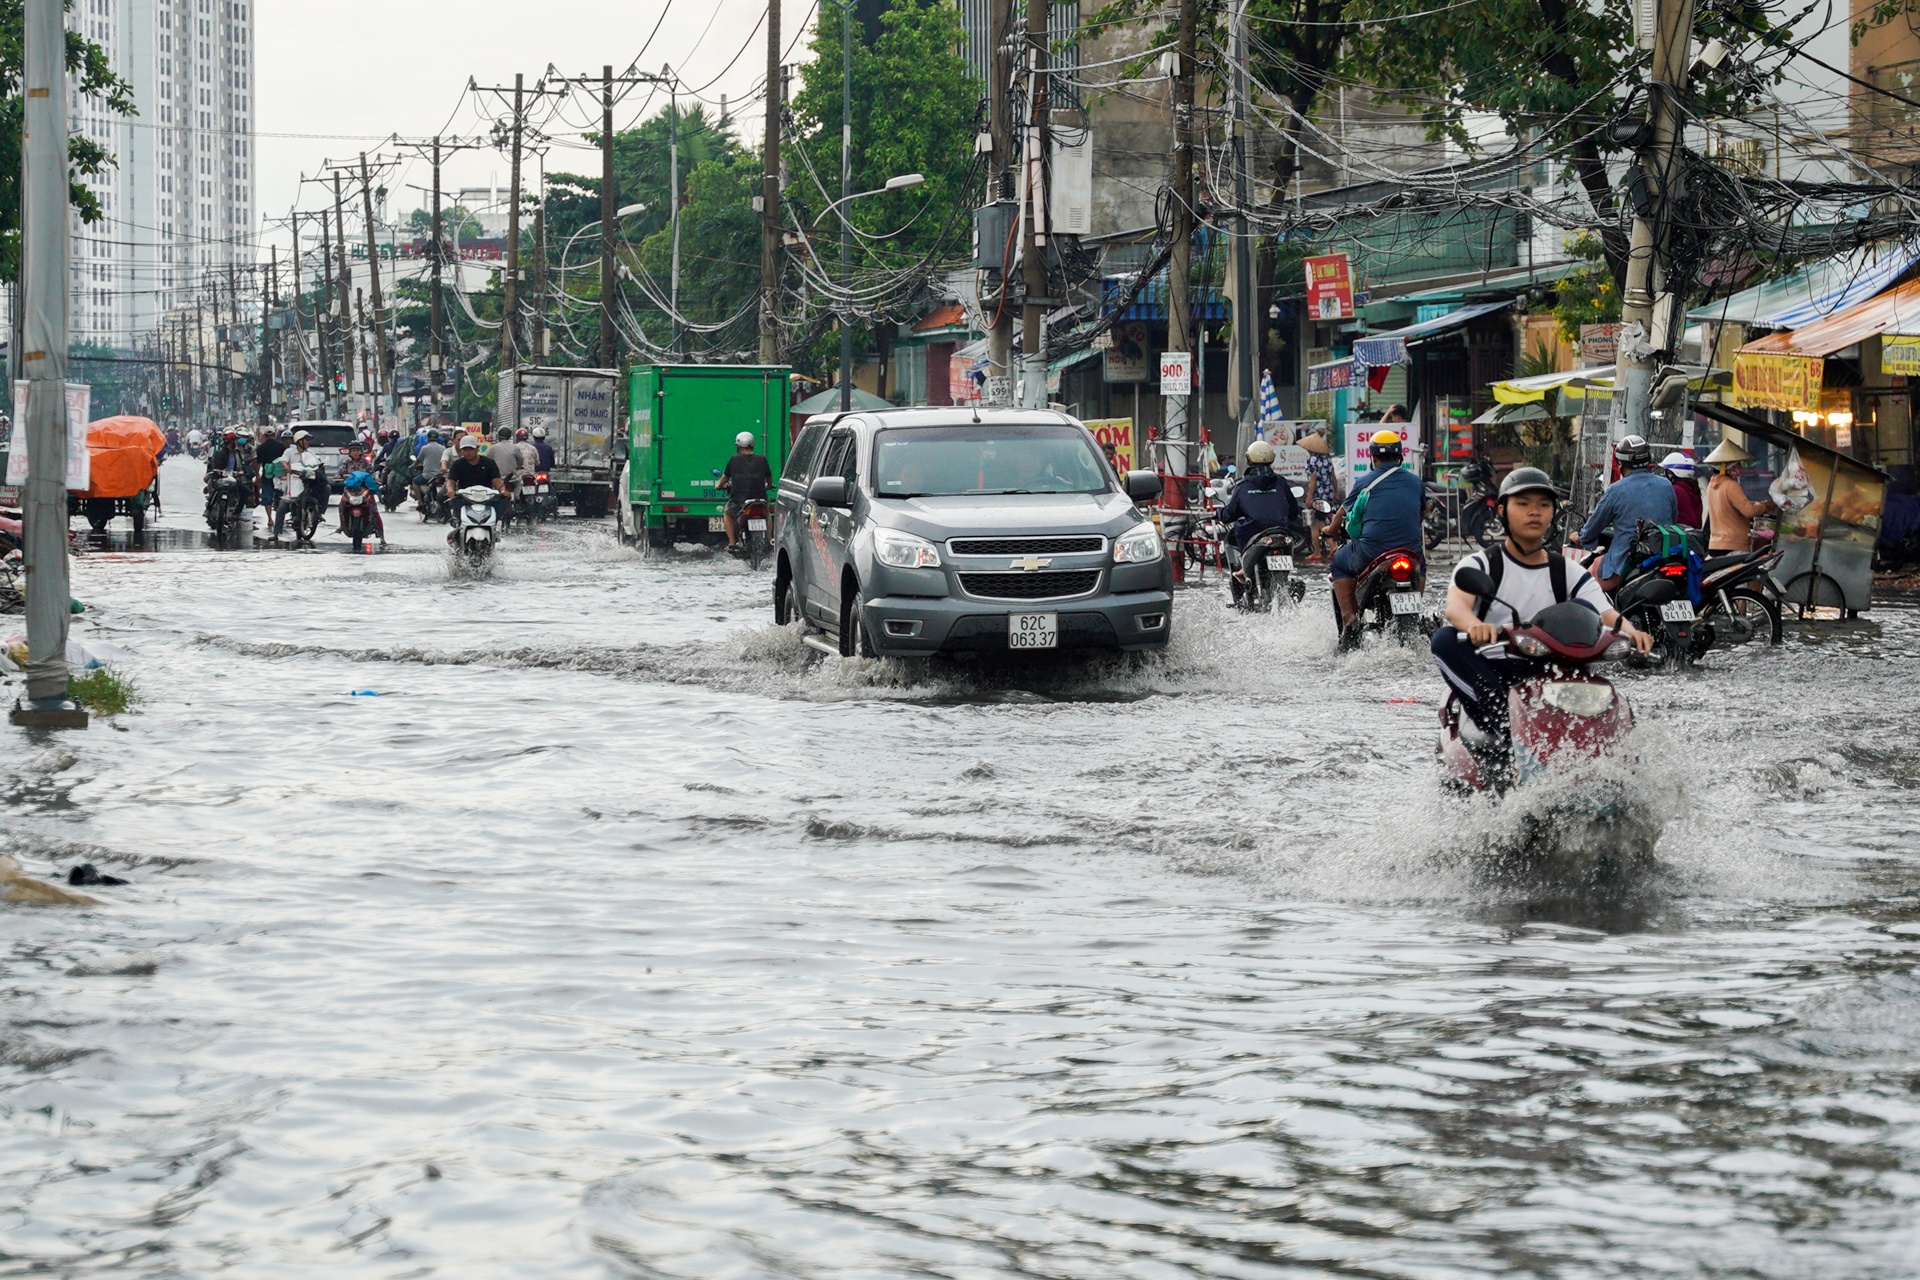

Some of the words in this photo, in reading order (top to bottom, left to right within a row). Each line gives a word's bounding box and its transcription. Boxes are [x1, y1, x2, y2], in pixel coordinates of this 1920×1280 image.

[1020, 615, 1046, 631] 62C
[1664, 611, 1693, 620] 941.03
[1010, 631, 1056, 647] 063.37
